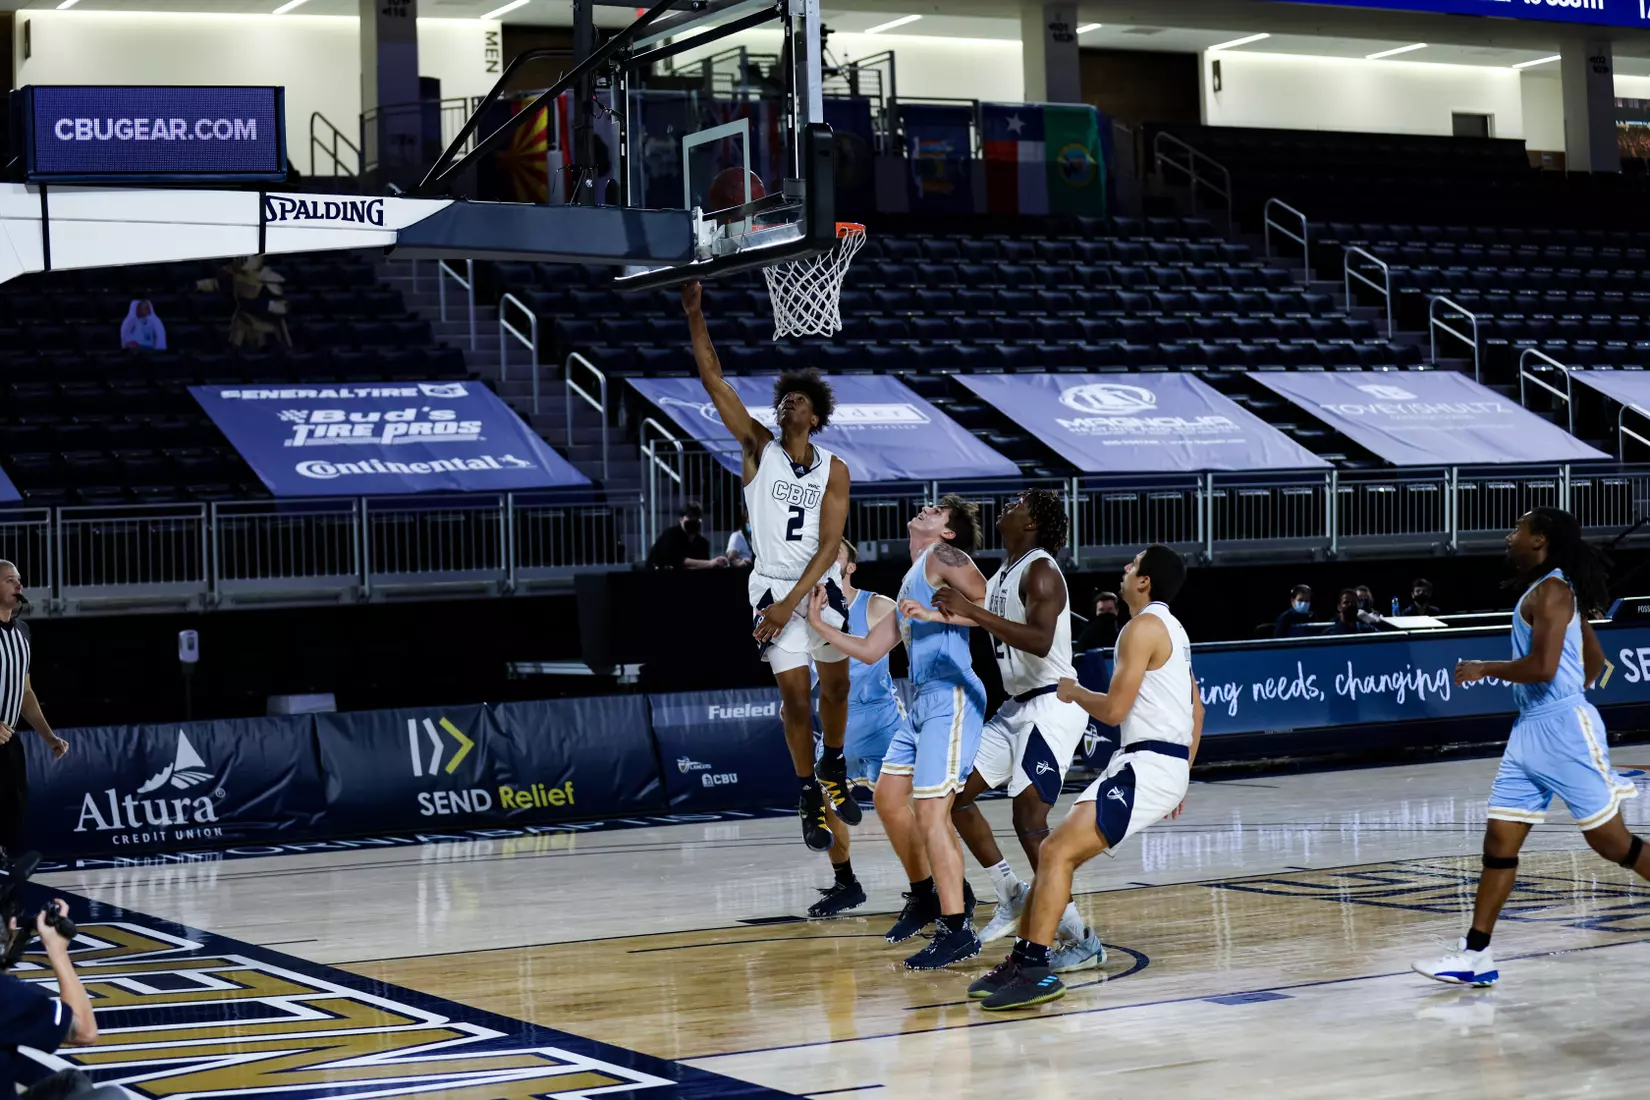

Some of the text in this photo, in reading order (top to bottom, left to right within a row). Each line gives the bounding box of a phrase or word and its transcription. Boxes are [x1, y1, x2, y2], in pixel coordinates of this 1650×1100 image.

[485, 31, 499, 73] MEN
[55, 118, 257, 141] CBUGEAR.COM
[265, 196, 384, 226] SPALDING
[309, 407, 456, 423] Bud's
[293, 422, 374, 446] TIRE
[295, 455, 500, 479] Continental
[772, 480, 820, 509] CBU
[786, 505, 805, 541] 2
[1252, 661, 1325, 702] needs,
[1335, 661, 1450, 704] changing
[708, 702, 776, 720] Fueled
[714, 773, 738, 785] CBU
[417, 781, 575, 816] SEND Relief
[112, 827, 223, 845] CREDIT UNION
